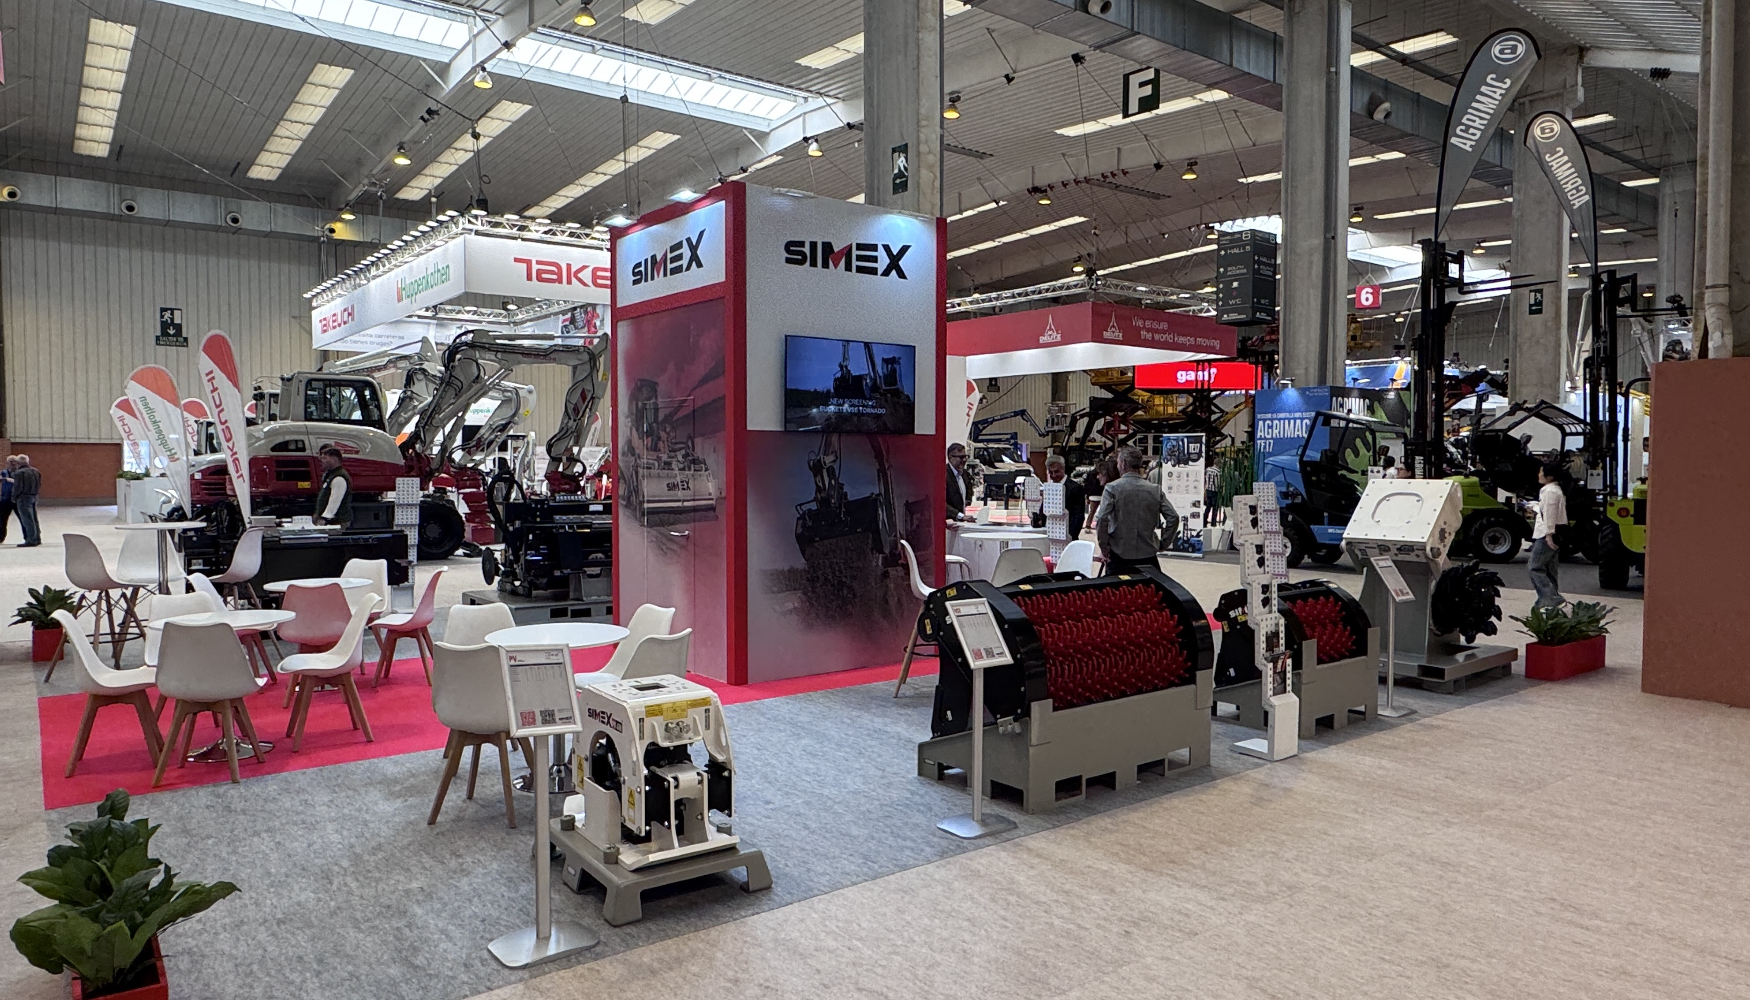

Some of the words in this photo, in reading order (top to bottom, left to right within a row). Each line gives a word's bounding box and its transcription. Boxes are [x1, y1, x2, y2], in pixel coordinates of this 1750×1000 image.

[1128, 67, 1155, 114] F
[1450, 73, 1512, 152] AGRIMAC
[1242, 231, 1250, 240] 6
[632, 228, 706, 286] SIMEX
[784, 240, 912, 280] SIMEX
[400, 261, 450, 305] Huppenkothen
[1360, 287, 1374, 306] 6
[318, 304, 355, 335] TAKEUCHI
[1131, 316, 1144, 328] We
[1145, 319, 1168, 330] ensure
[1140, 329, 1153, 340] the
[1154, 332, 1173, 343] world
[1174, 333, 1195, 347] keeps
[1196, 337, 1220, 350] moving
[820, 405, 847, 413] BUCKETS
[859, 406, 886, 414] TORNADO
[1257, 419, 1310, 438] AGRIMAC
[666, 479, 691, 491] SIMEX
[588, 707, 612, 728] SIMEX
